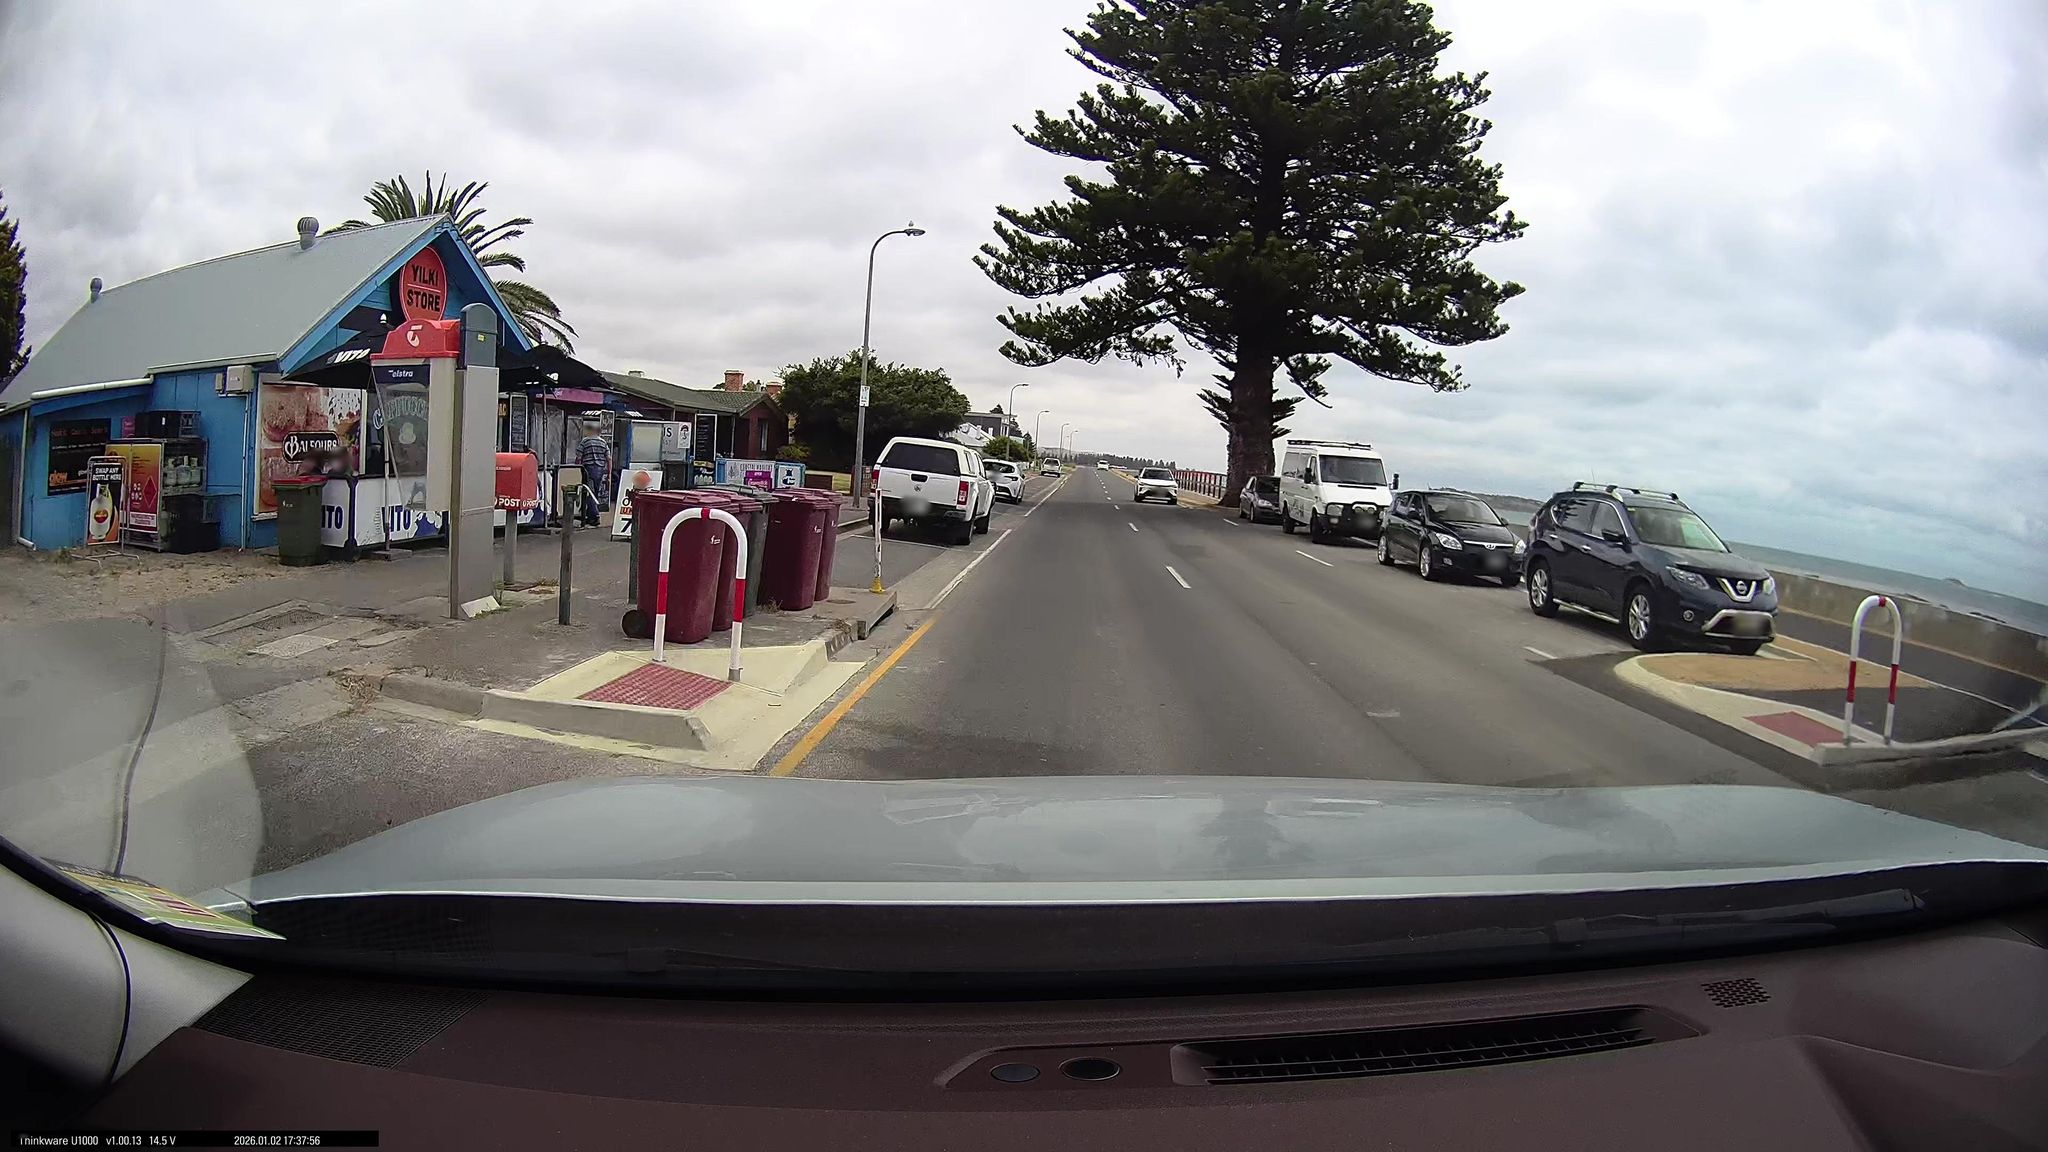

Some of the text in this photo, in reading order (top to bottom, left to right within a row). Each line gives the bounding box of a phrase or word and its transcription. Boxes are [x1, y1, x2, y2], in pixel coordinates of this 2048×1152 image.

[411, 264, 439, 287] YILKI
[406, 289, 441, 312] STORE
[388, 369, 414, 378] Telstra
[498, 498, 520, 507] POST
[321, 505, 344, 530] ITO
